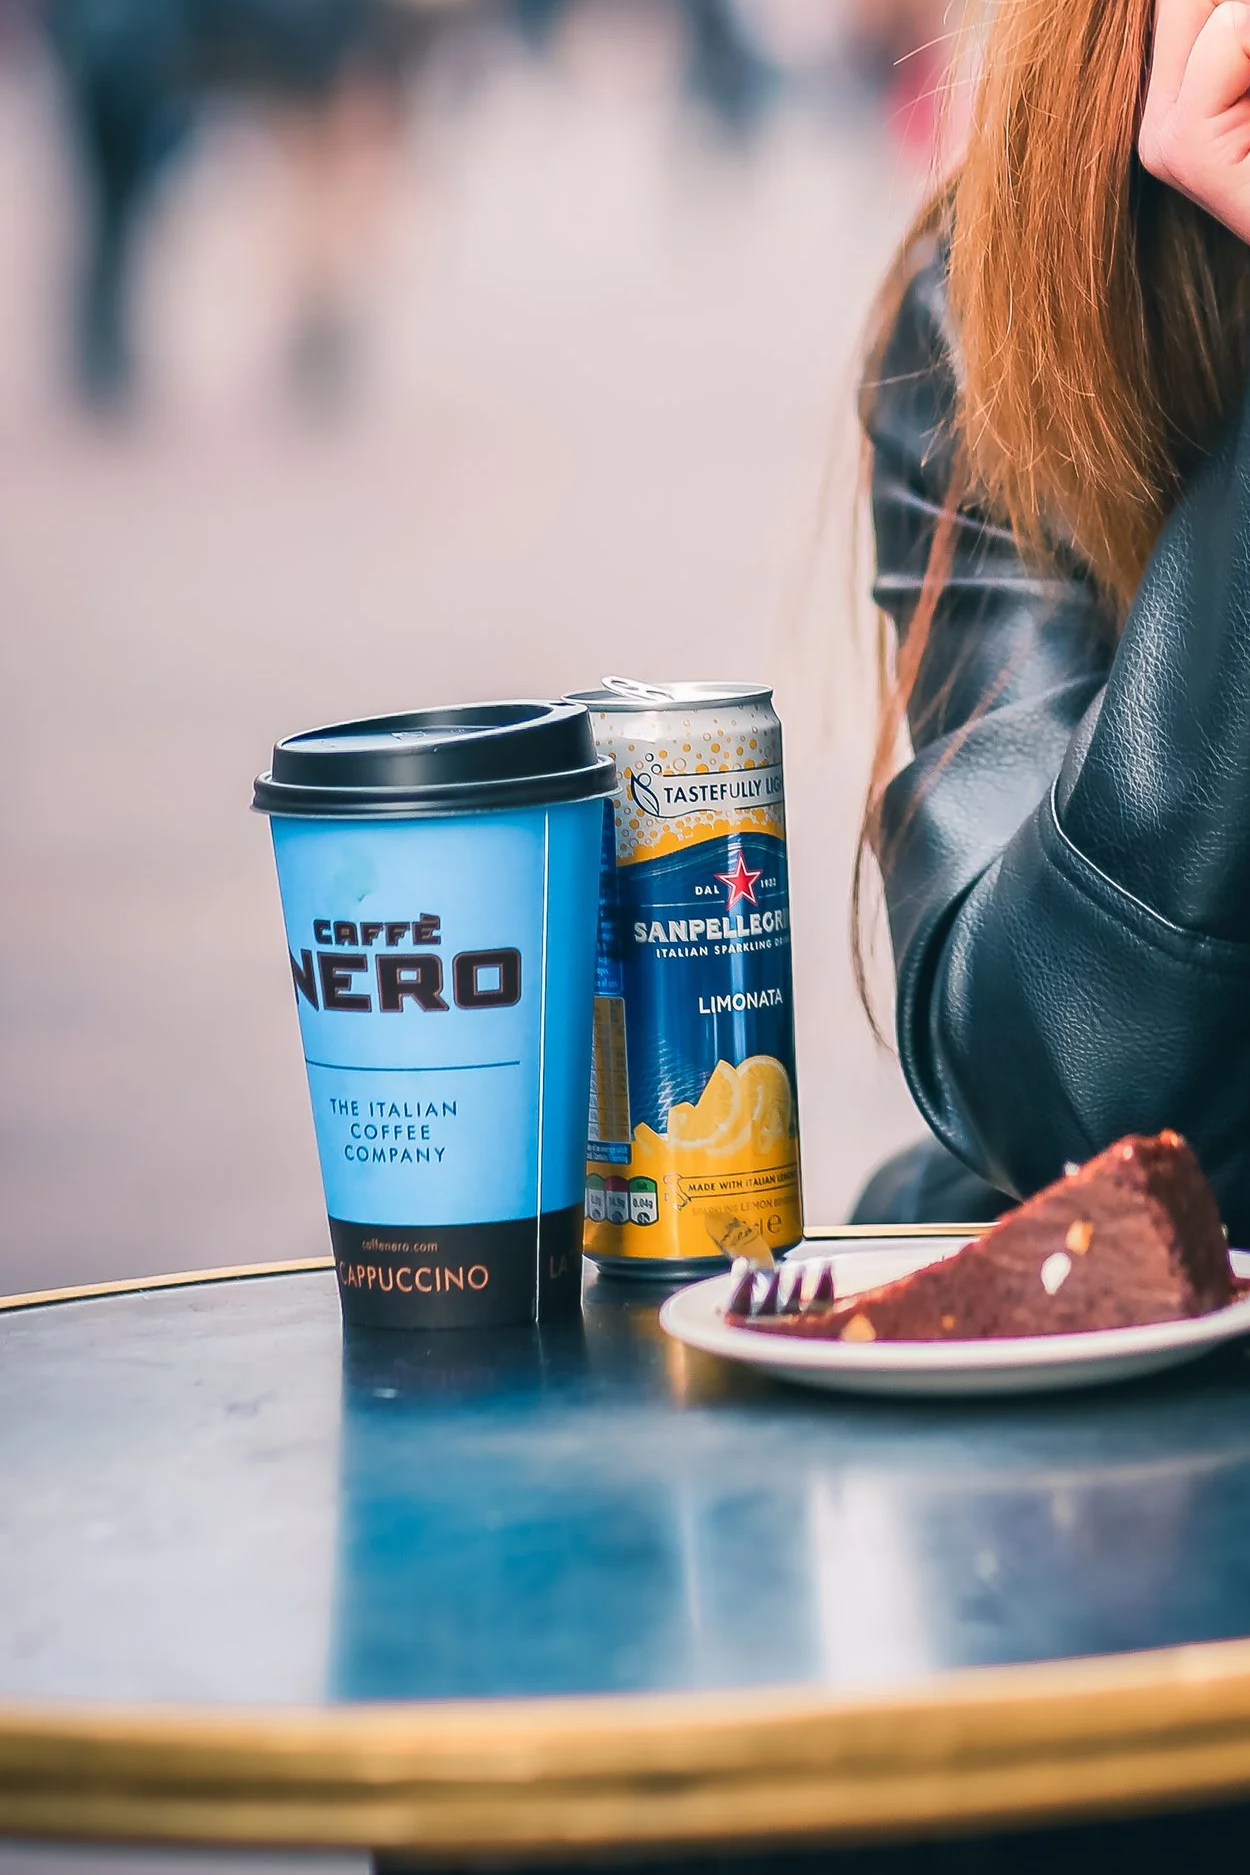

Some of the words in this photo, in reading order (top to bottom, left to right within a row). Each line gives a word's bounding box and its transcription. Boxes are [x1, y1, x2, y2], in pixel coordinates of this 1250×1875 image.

[664, 779, 761, 803] TASTEFULLY
[766, 775, 782, 794] LIG
[695, 885, 720, 896] DAL
[313, 913, 441, 946] CAFFÈ
[634, 909, 788, 943] SANPELLEGRI
[656, 946, 708, 958] ITALIAN
[714, 938, 772, 955] SPARKLING
[290, 947, 522, 1013] NERO
[698, 988, 783, 1014] LIMONATA
[329, 1098, 359, 1116] THE
[369, 1101, 457, 1118] ITALIAN
[351, 1123, 430, 1140] COFFEE
[344, 1144, 446, 1163] COMPANY
[688, 1182, 715, 1192] MADE
[719, 1180, 743, 1190] WITH
[746, 1174, 779, 1187] ITALIAN
[339, 1261, 489, 1293] CAPPUCCINO
